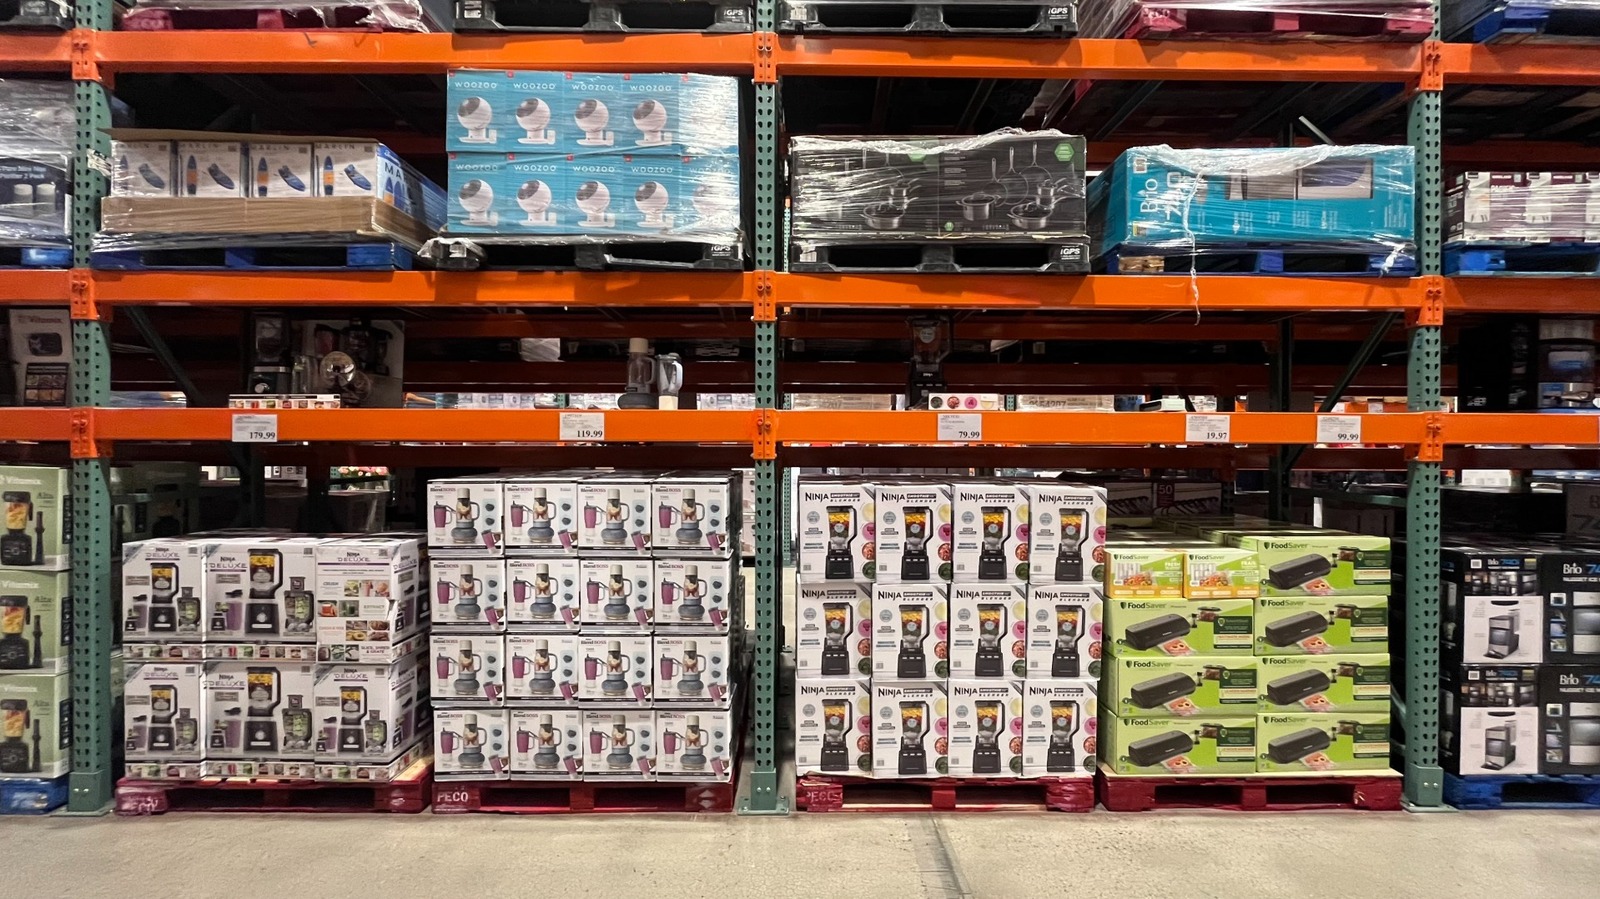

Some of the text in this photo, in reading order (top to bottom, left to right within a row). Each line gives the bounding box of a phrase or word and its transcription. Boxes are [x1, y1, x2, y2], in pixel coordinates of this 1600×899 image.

[454, 81, 497, 89] WOOZOO
[513, 82, 556, 90] WOOZOO
[1139, 178, 1159, 214] Brio
[249, 431, 276, 439] 179.99
[577, 430, 603, 438] 119.99
[958, 431, 980, 439] 79.99
[1206, 432, 1227, 440] 19.97
[1337, 433, 1359, 441] 99.99
[1159, 485, 1173, 494] 50
[805, 492, 829, 503] NINJA
[881, 492, 906, 503] NINJA
[960, 492, 984, 503] NINJA
[1039, 493, 1063, 504] NINJA
[1563, 562, 1583, 575] Brio
[802, 589, 826, 599] NINJA
[878, 591, 902, 601] NINJA
[956, 589, 980, 600] NINJA
[1035, 590, 1059, 601] NINJA
[1559, 673, 1579, 685] Brio
[801, 685, 825, 696] NINJA
[878, 688, 902, 698] NINJA
[954, 686, 978, 697] NINJA
[1029, 686, 1053, 697] NINJA
[437, 791, 469, 802] PECO
